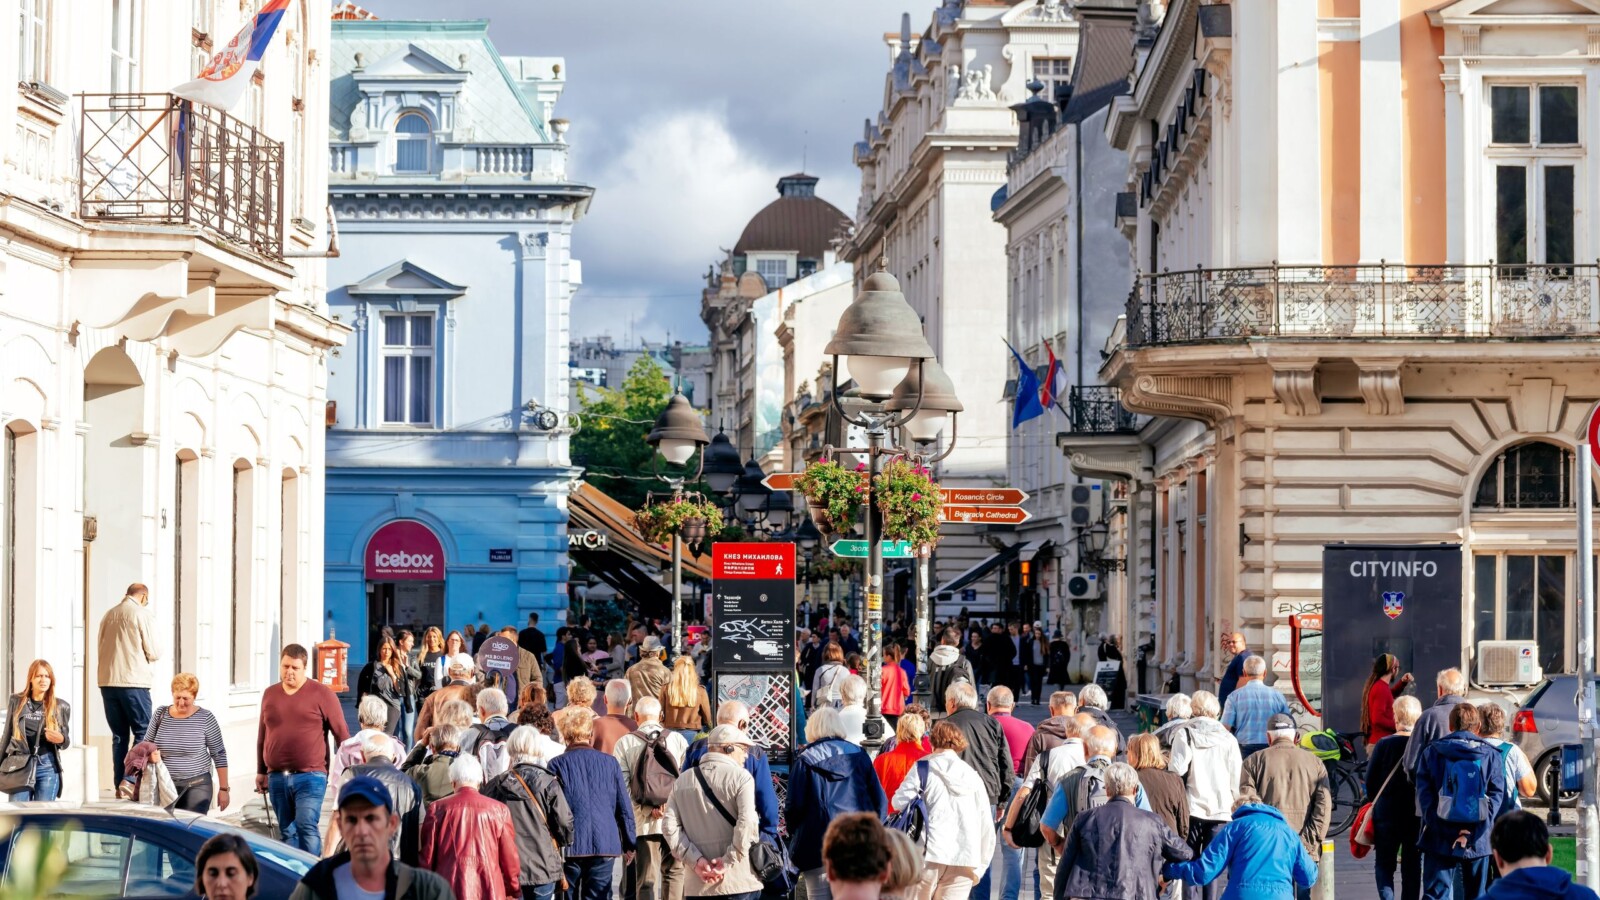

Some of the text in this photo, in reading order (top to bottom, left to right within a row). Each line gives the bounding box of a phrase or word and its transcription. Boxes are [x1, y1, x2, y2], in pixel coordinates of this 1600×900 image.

[954, 511, 1018, 519] Belgrade Cathedral
[567, 531, 606, 548] ATCH
[375, 550, 434, 568] icebox
[1350, 560, 1438, 577] CITYINFO
